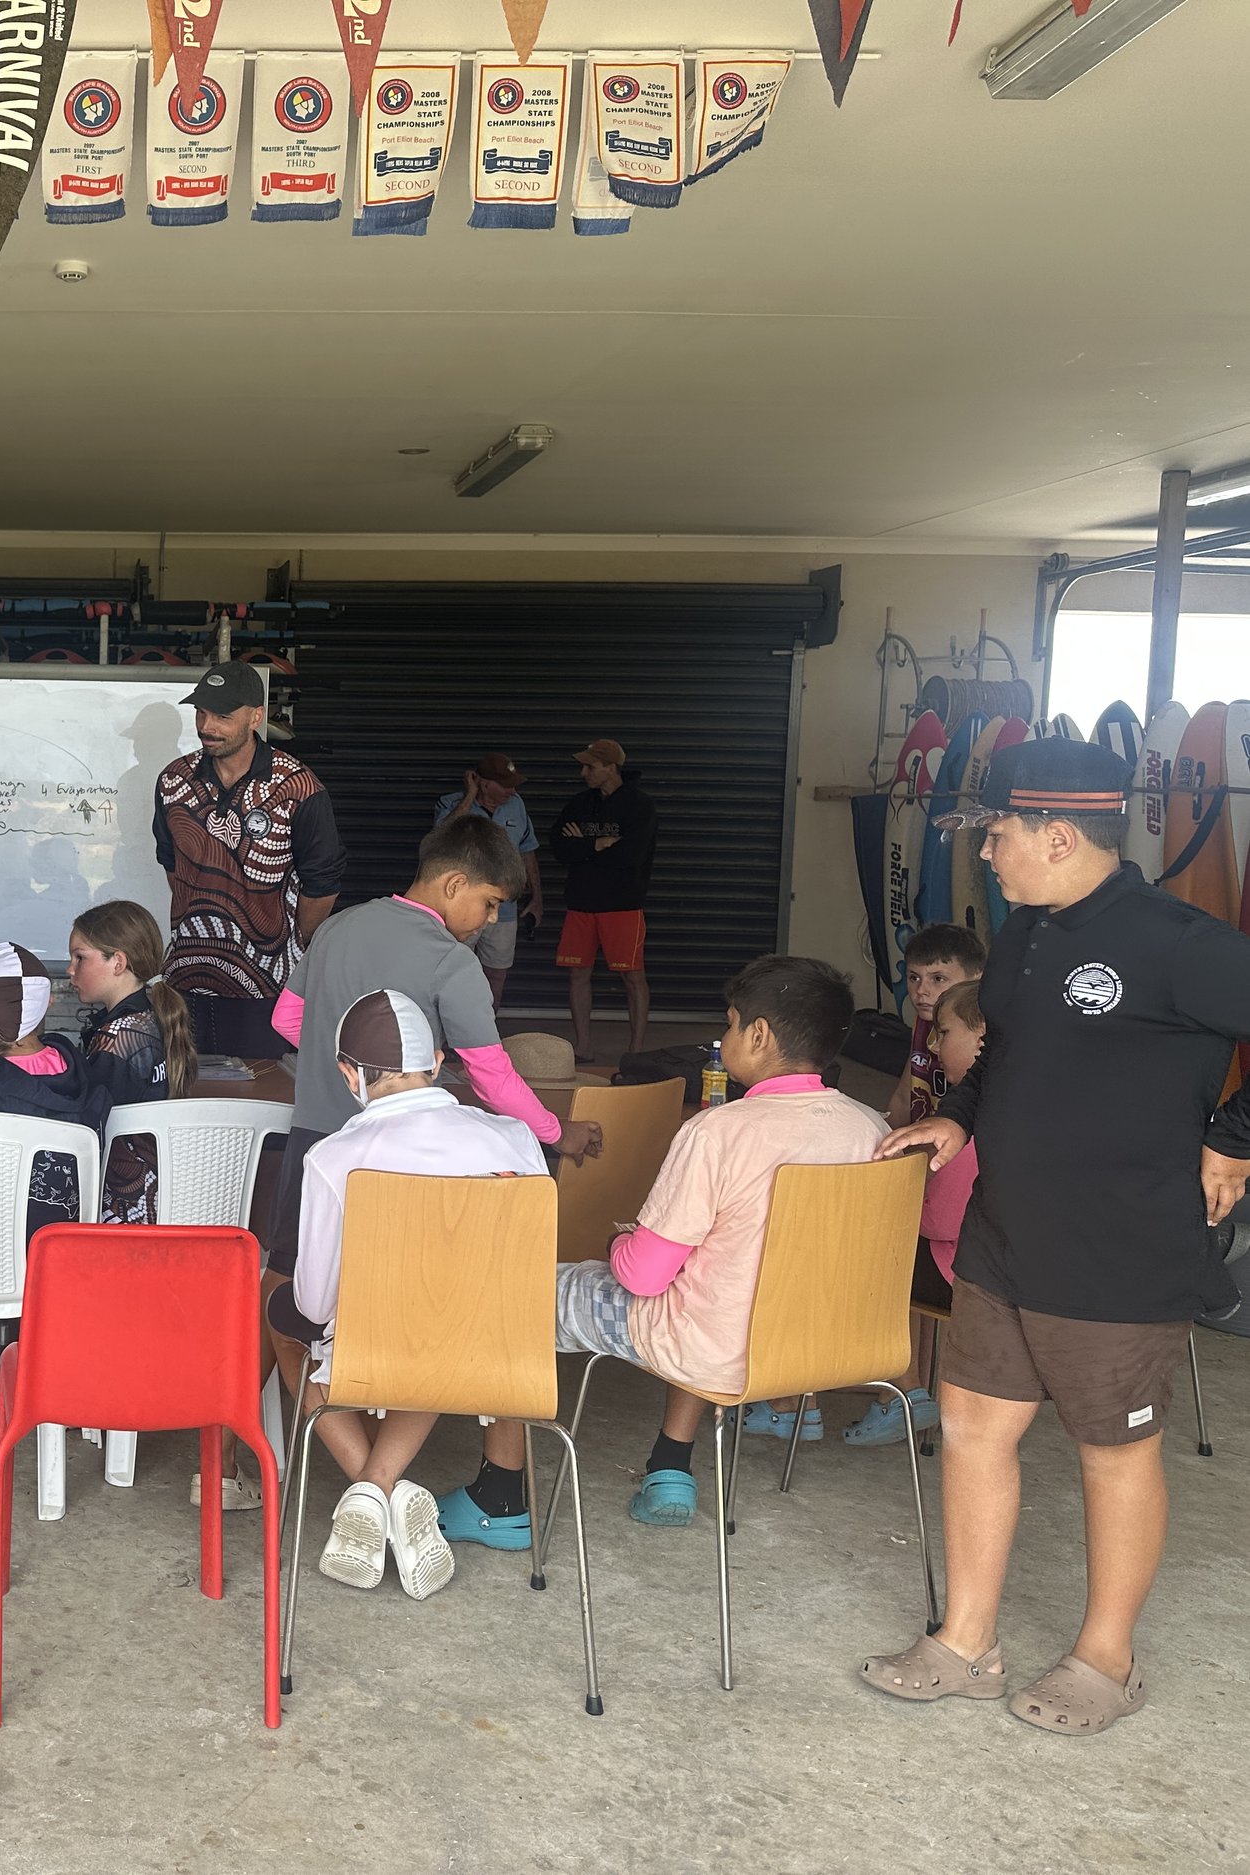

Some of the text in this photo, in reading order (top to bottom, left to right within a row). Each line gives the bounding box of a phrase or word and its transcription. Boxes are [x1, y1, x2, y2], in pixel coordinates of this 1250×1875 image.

[647, 83, 666, 91] 2008
[641, 90, 673, 99] MASTERS
[413, 99, 448, 107] MASTERS
[645, 100, 669, 109] STATE
[606, 107, 672, 118] CHAMPIONSHIPS
[377, 120, 445, 130] CHAMPIONSHIPS
[487, 120, 556, 128] CHAMPIONSHIPS
[644, 122, 663, 131] Beach
[414, 136, 435, 144] Beach
[285, 159, 315, 168] THIRD
[618, 158, 662, 175] SECOND
[76, 165, 102, 174] FIRST
[179, 165, 207, 174] SECOND
[385, 179, 431, 192] SECOND
[495, 180, 540, 192] SECOND
[1146, 749, 1161, 836] FORC FIELD
[891, 842, 901, 927] FORCE FIELD
